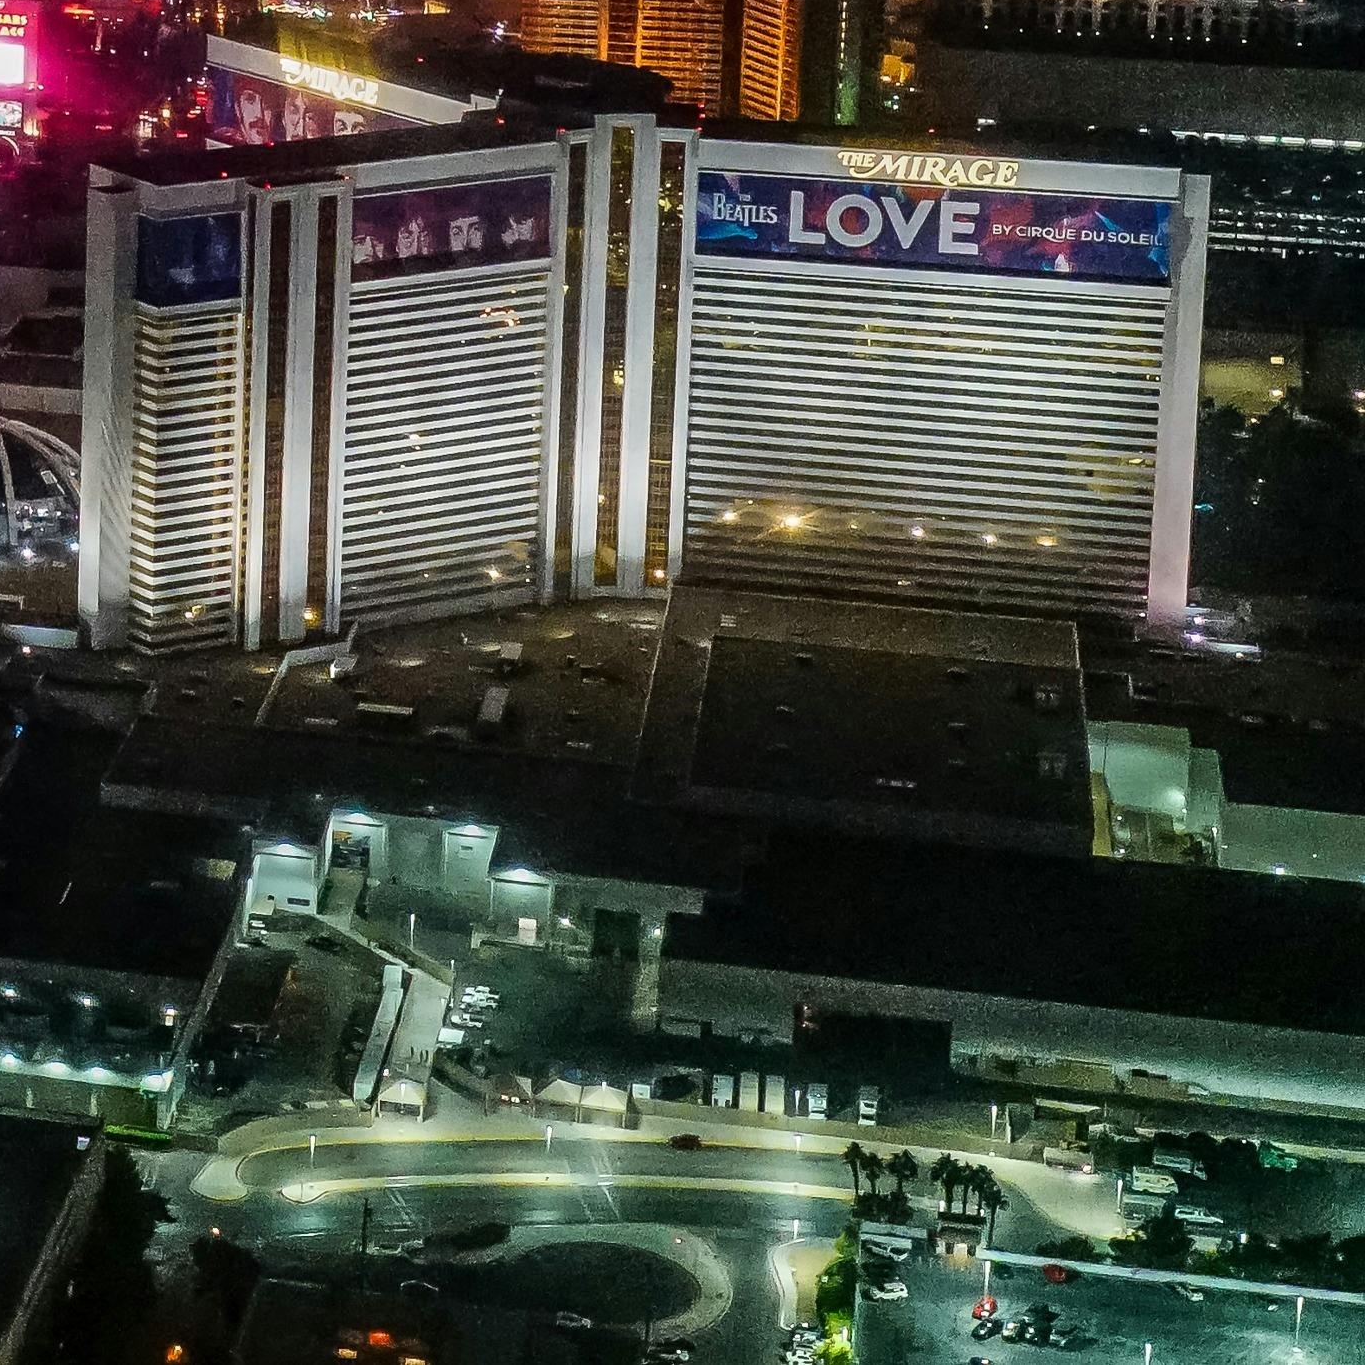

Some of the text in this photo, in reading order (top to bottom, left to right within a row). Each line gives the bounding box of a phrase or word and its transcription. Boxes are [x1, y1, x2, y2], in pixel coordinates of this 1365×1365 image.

[837, 151, 1019, 186] THE MIRAGE
[789, 190, 980, 256] LOVE
[992, 224, 1164, 247] BY CIRQUE DU SOLEIL
